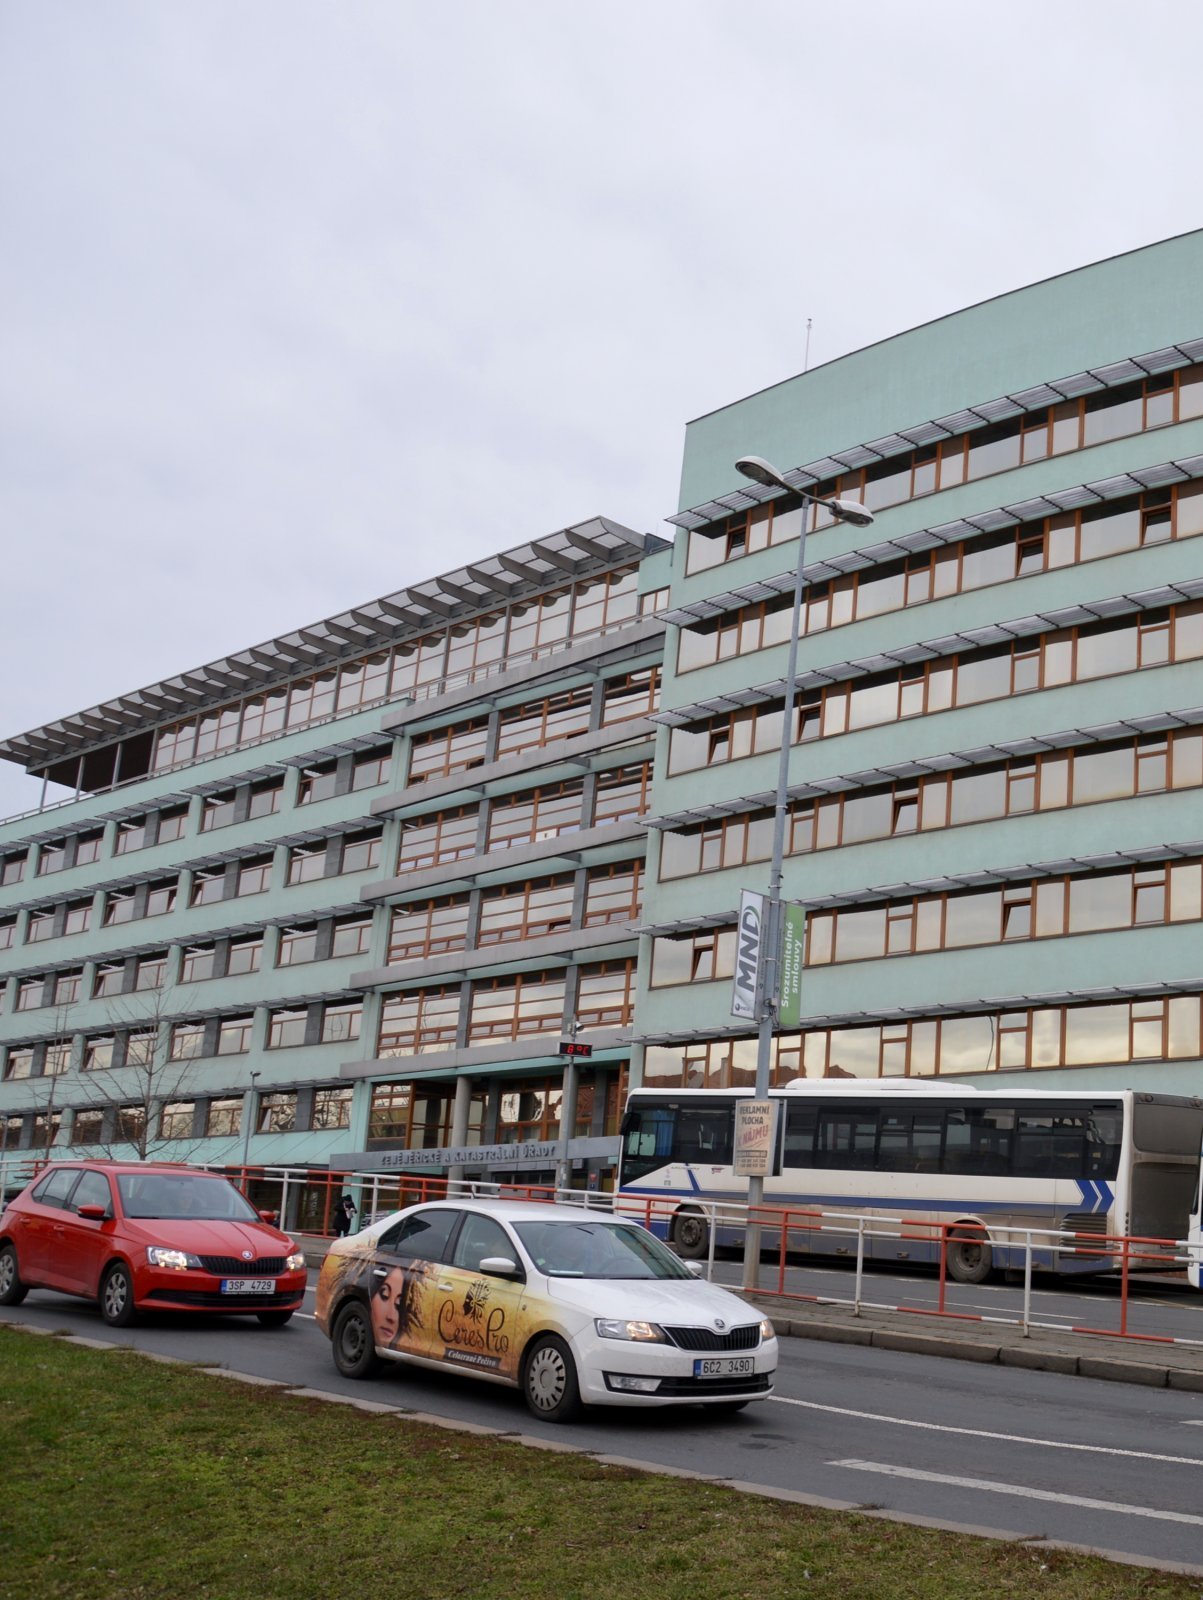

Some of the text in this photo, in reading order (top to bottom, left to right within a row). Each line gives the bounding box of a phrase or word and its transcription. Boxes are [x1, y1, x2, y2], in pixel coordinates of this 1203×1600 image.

[737, 905, 760, 993] MND
[781, 922, 794, 1008] Srozumitelné
[791, 940, 802, 993] smlouvy
[741, 1115, 764, 1125] PLOCHA
[454, 1145, 520, 1163] KATASTRÁLNÍ
[521, 1144, 557, 1159] ÚŘADY
[228, 1280, 273, 1291] 3SP 4729
[703, 1359, 750, 1374] 6C2 3490
